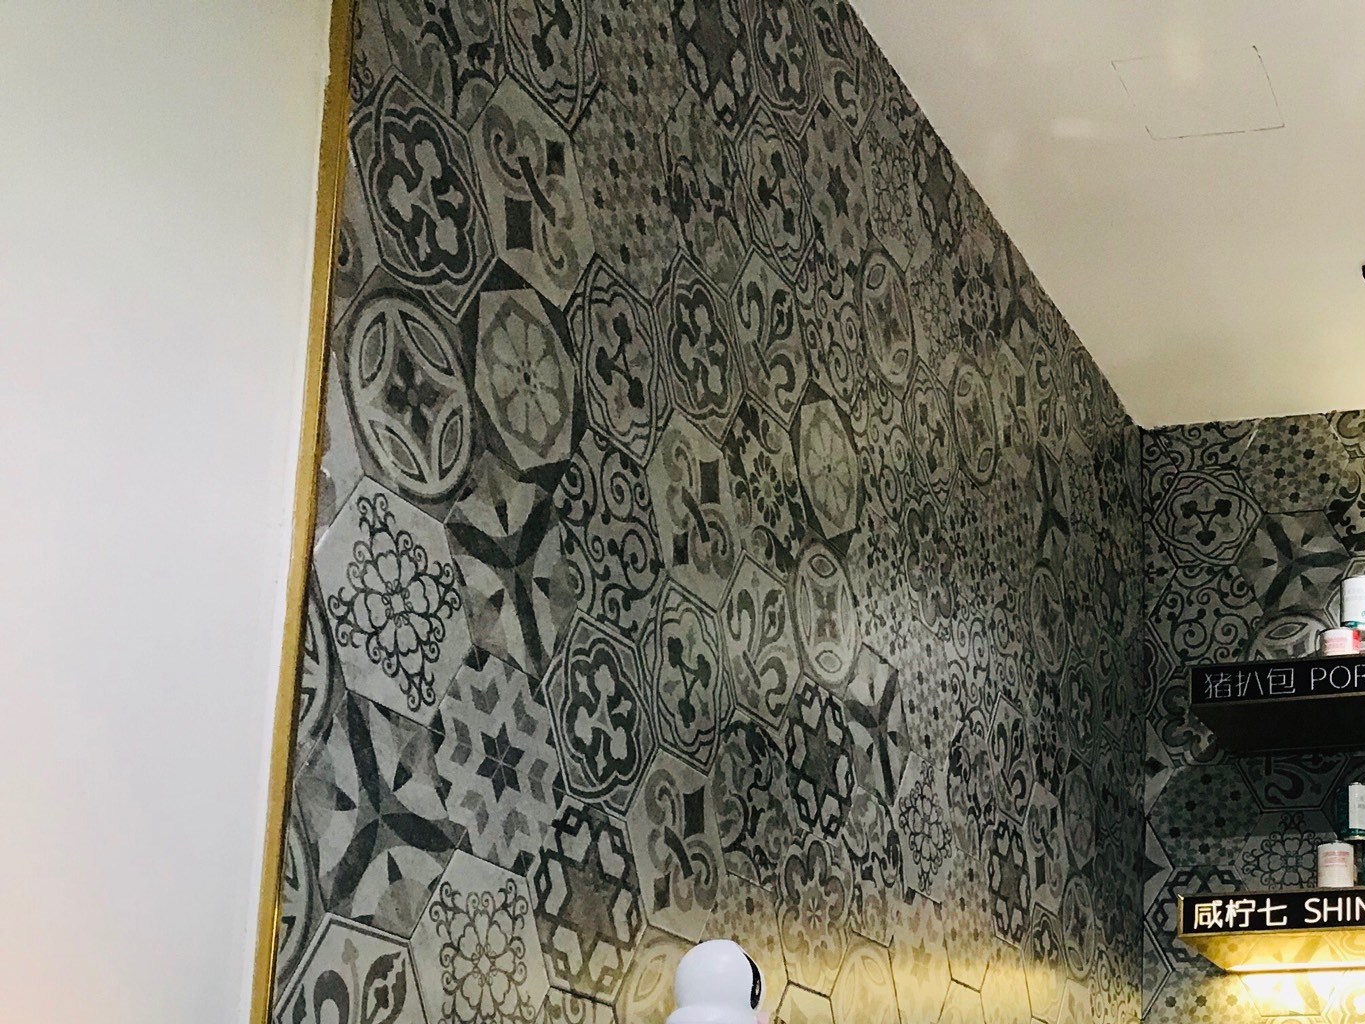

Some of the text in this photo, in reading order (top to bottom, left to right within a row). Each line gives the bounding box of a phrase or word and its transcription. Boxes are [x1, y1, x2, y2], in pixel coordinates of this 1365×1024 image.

[1203, 667, 1296, 699] 猪扒包
[1193, 898, 1288, 930] 咸柠七
